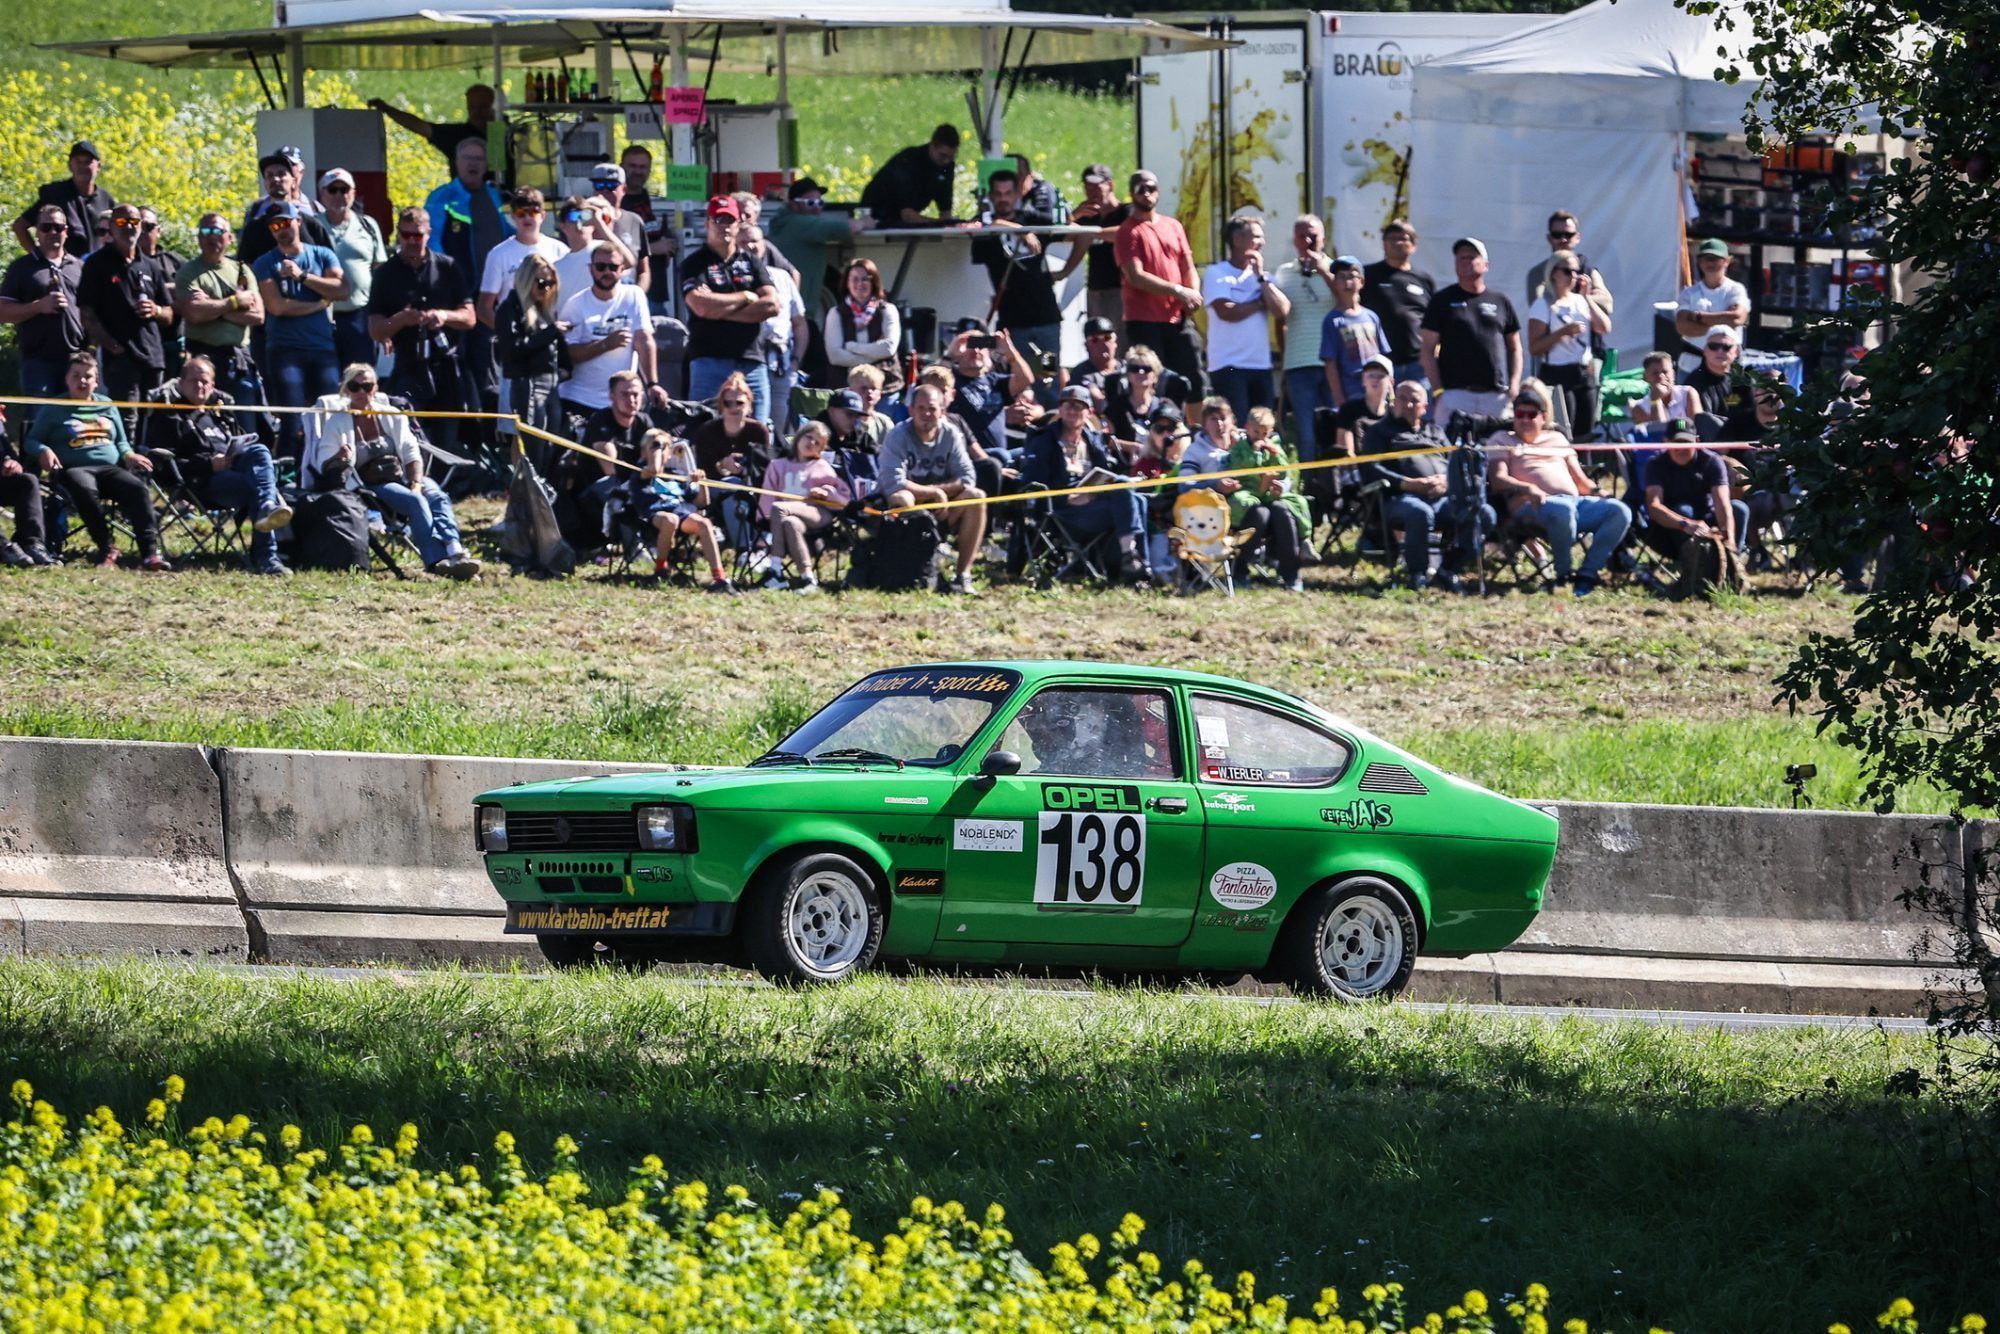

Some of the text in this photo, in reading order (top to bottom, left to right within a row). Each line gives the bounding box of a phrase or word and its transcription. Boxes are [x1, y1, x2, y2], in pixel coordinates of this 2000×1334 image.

[1218, 766, 1264, 780] W.TERLER
[1045, 786, 1140, 811] OPEL
[1204, 799, 1256, 814] hubersport
[1041, 813, 1141, 902] 138
[1236, 867, 1257, 875] PIZZA
[899, 876, 940, 888] Kadett
[1214, 873, 1274, 897] Fantastico
[518, 905, 670, 930] www.kartbahn-treff.at
